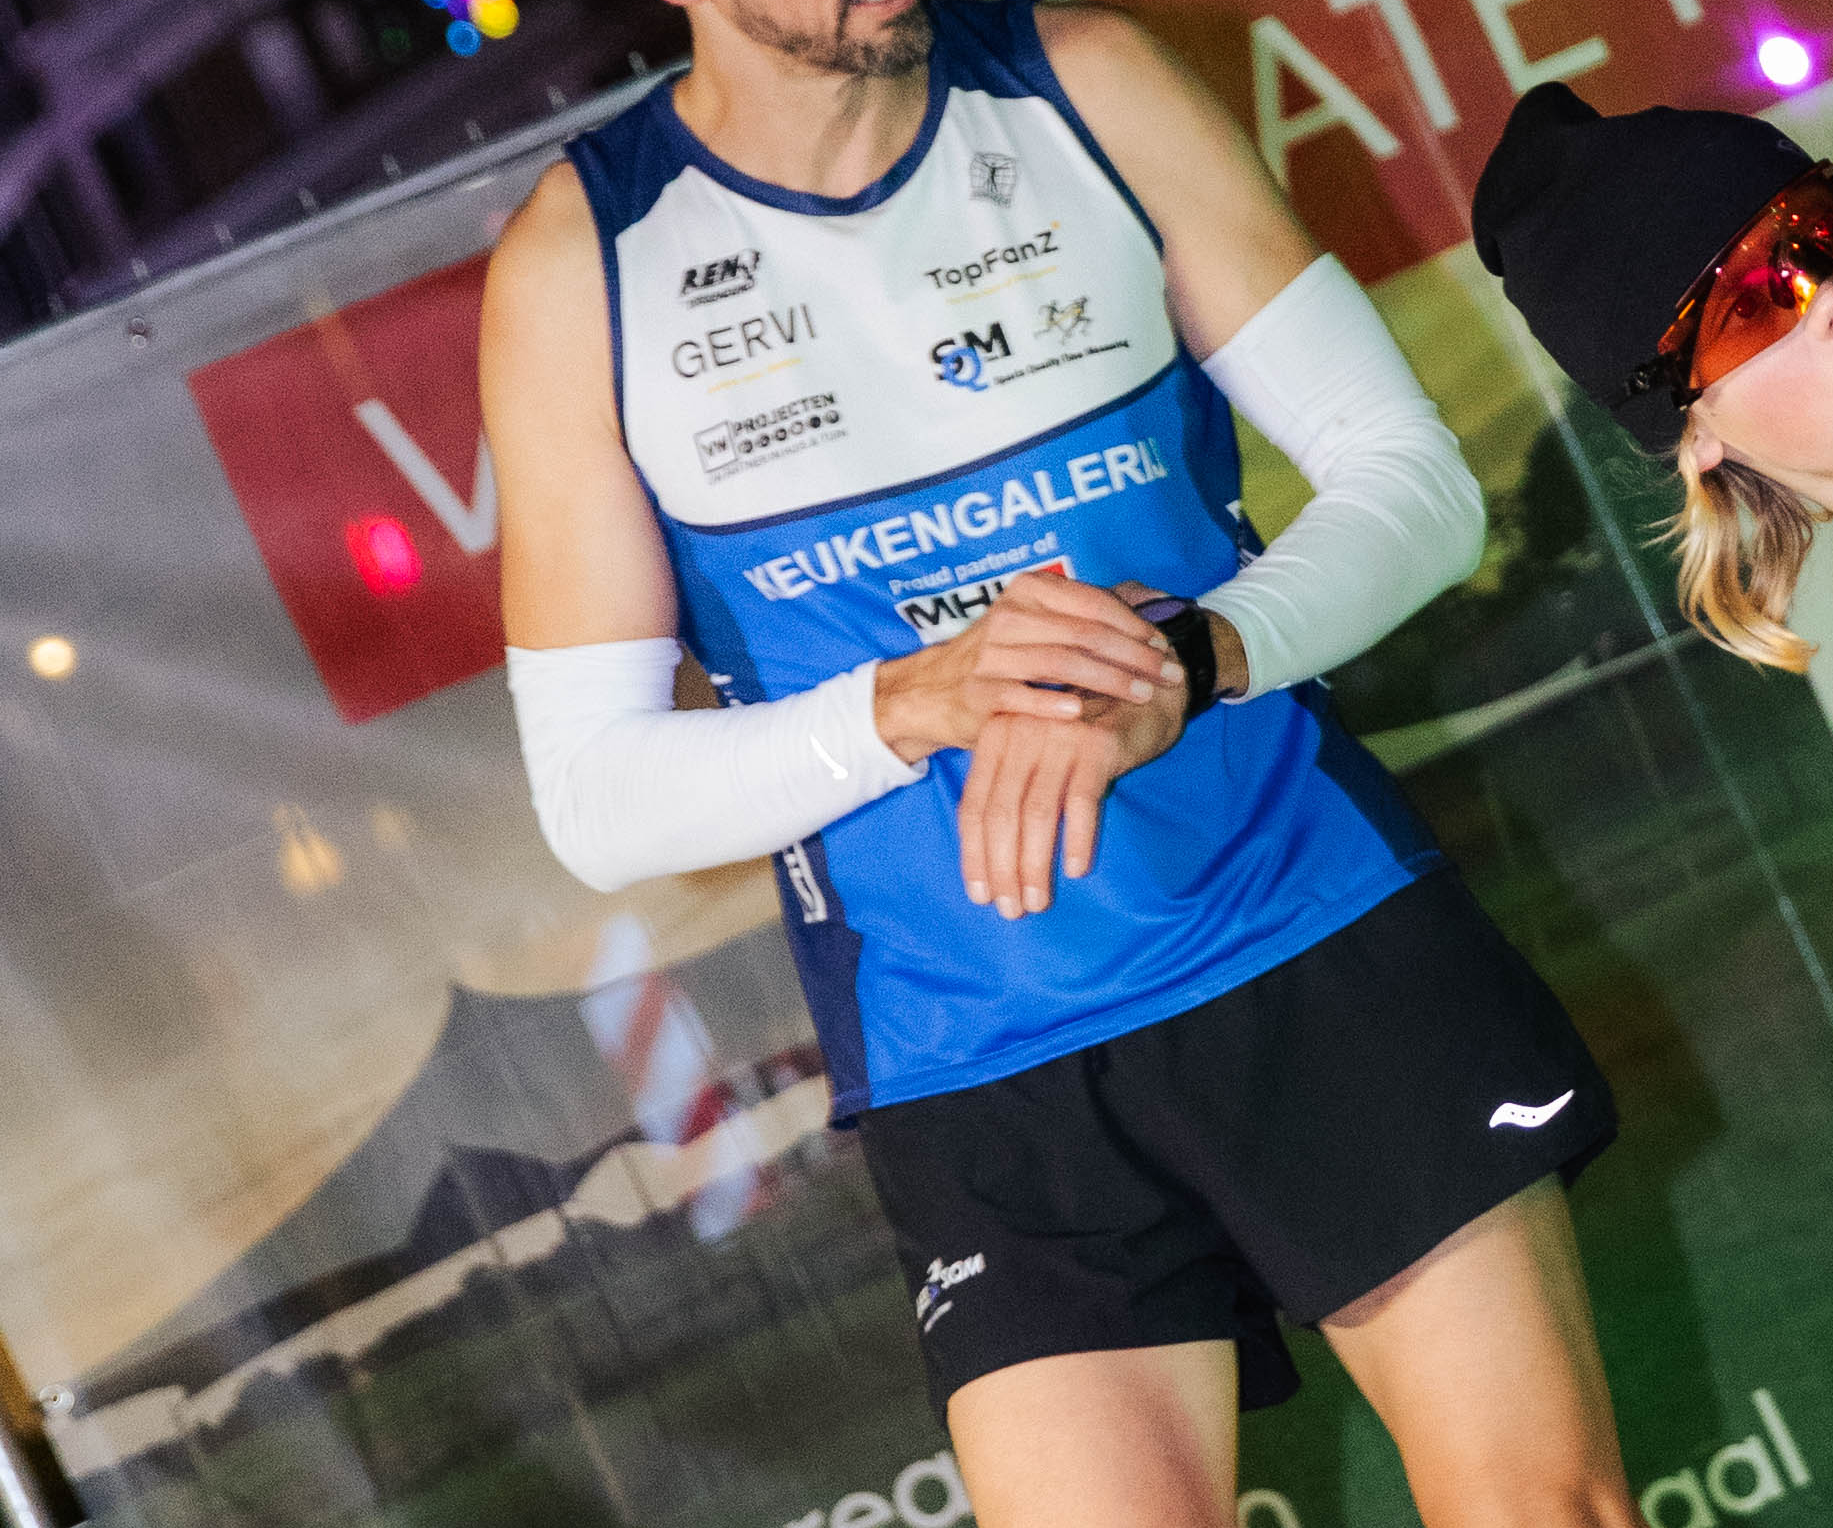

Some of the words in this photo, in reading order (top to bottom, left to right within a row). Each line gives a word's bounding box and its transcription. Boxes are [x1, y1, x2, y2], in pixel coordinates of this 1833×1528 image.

[926, 230, 1059, 289] TopFanZ
[672, 303, 817, 378] GERVI
[734, 391, 836, 437] PROJECTEN
[888, 565, 954, 595] Proud
[954, 544, 1030, 583] partner
[1033, 530, 1059, 555] of
[903, 581, 1005, 630] MH
